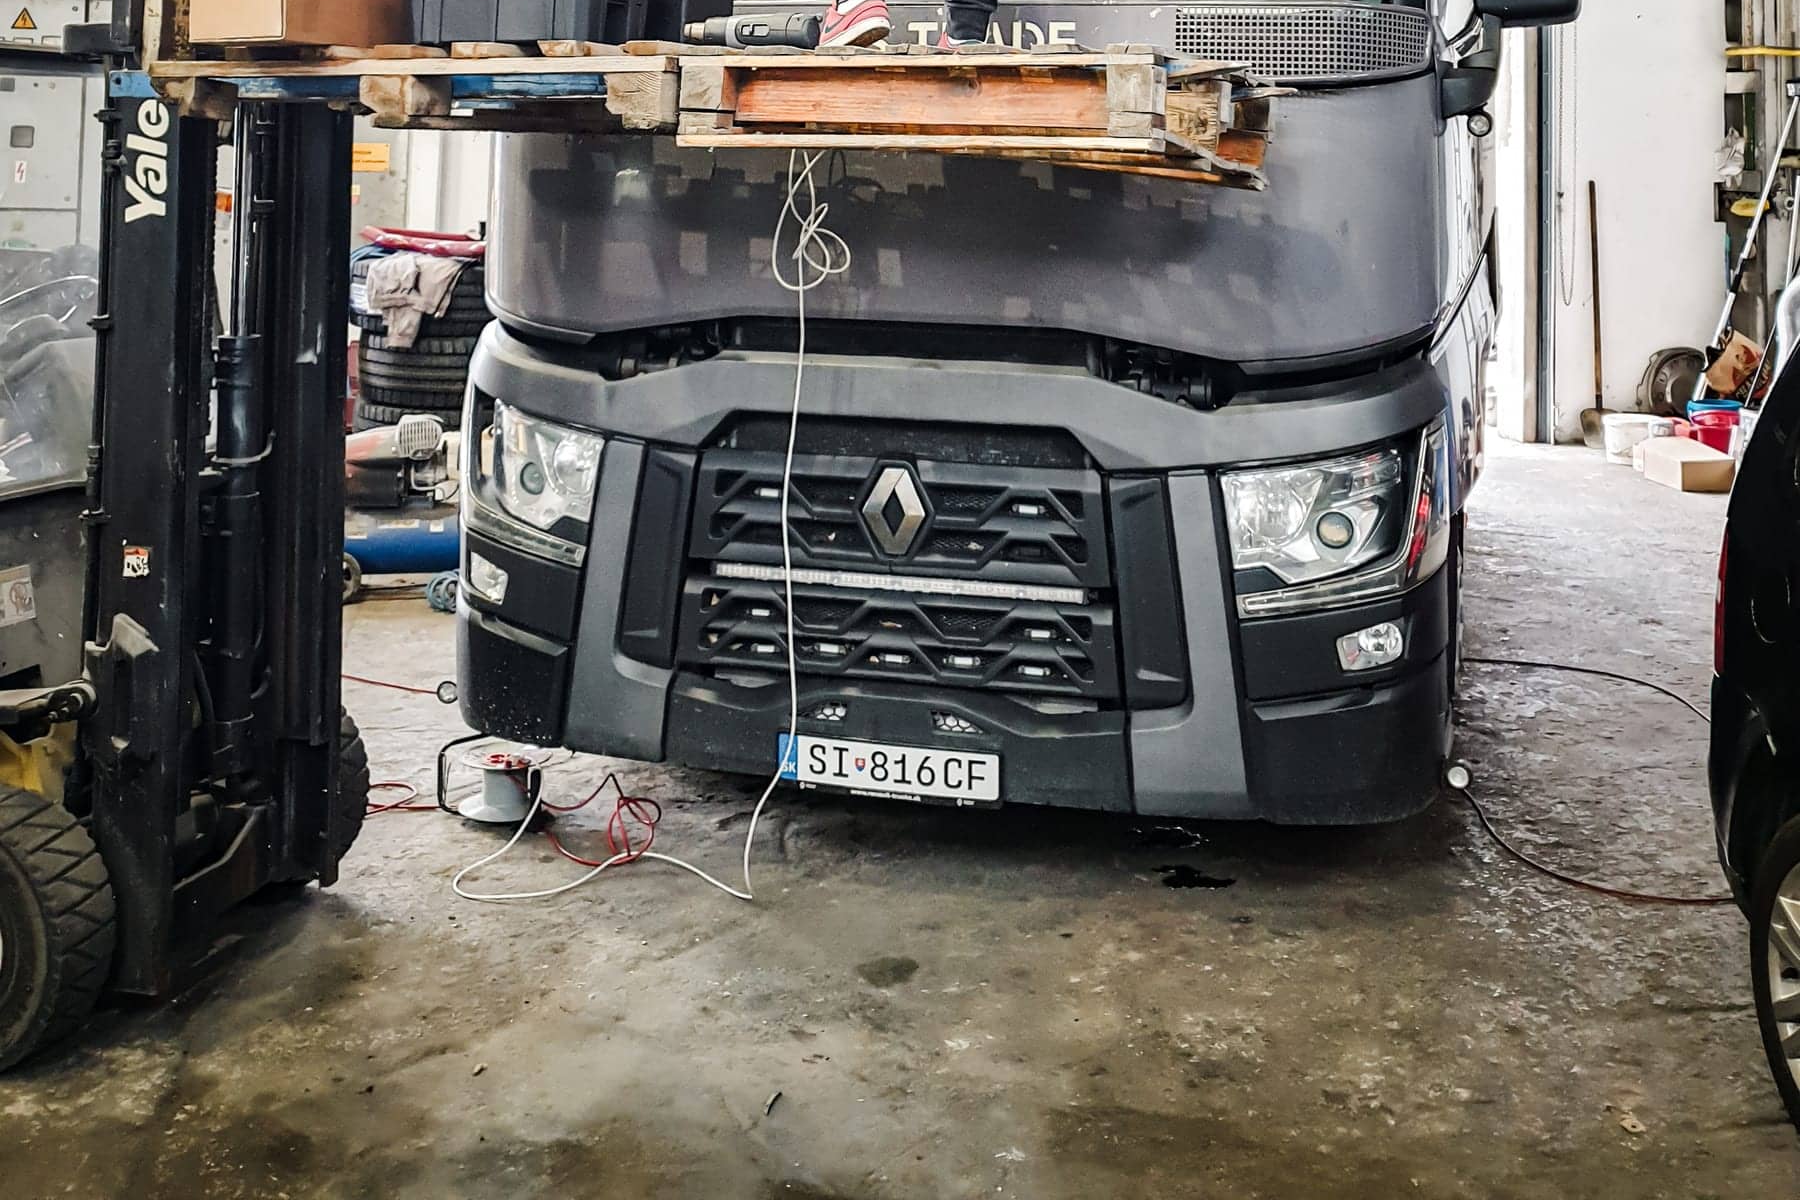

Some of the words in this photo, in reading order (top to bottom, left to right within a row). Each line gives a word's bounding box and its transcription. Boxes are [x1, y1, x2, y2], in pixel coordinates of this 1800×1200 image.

[908, 20, 1077, 51] TADE
[124, 99, 170, 223] Yale
[808, 744, 850, 778] SI
[870, 750, 987, 791] 816CF
